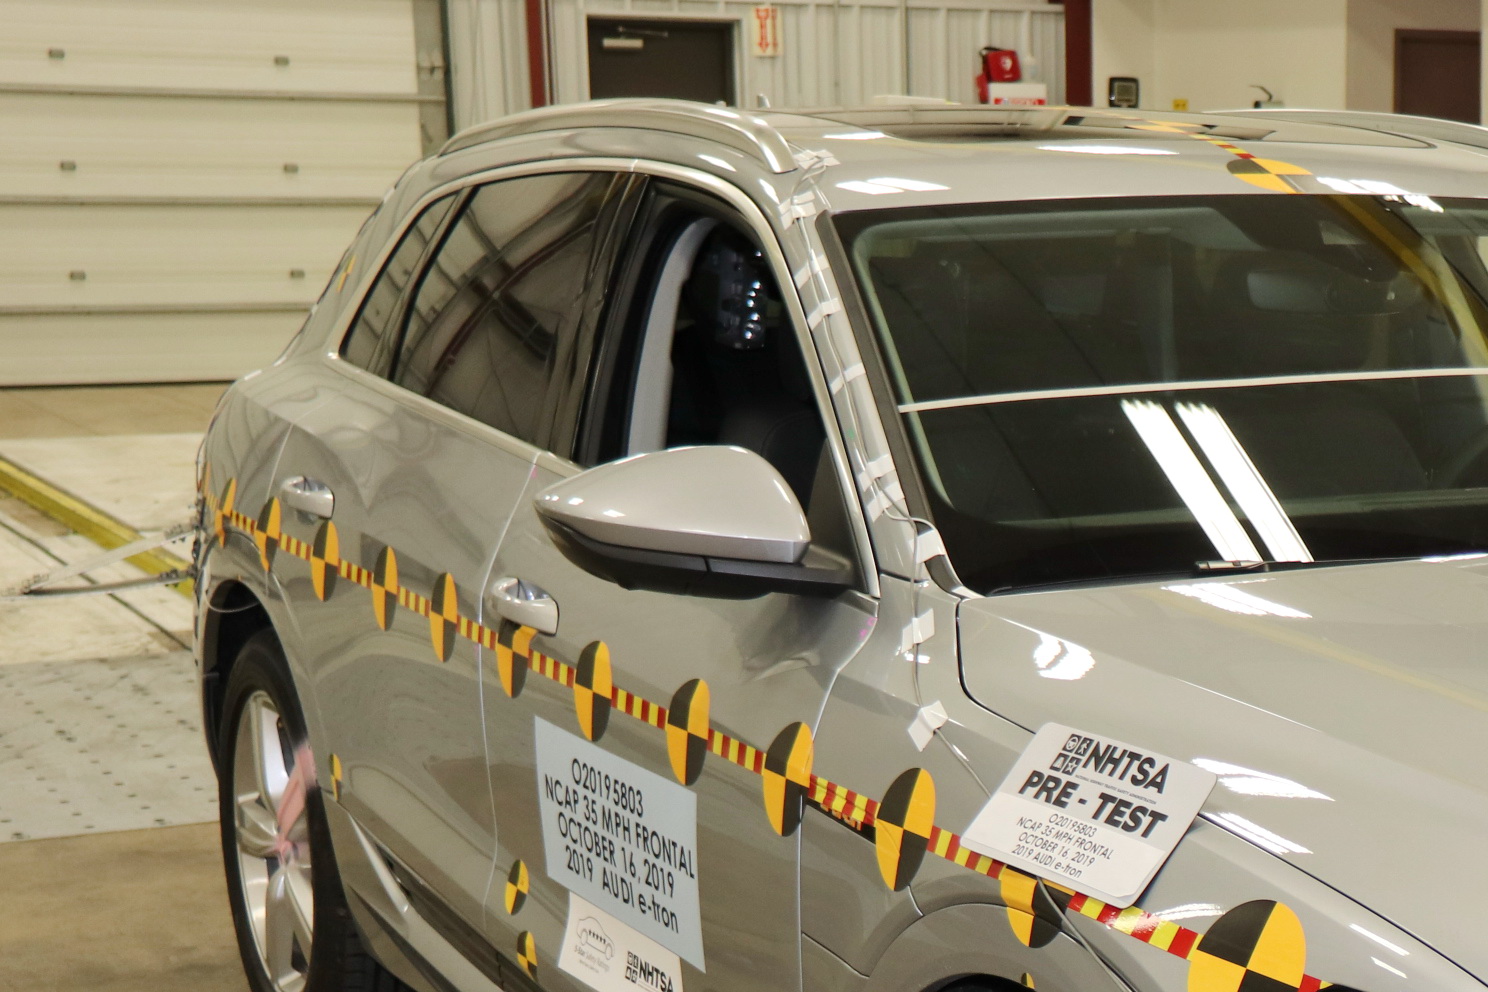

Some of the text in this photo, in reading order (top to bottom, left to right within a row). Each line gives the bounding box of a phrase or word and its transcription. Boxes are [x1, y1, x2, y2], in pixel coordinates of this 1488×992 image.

[571, 758, 644, 818] O20195803
[1080, 741, 1170, 795] NHTSA
[545, 773, 695, 879] NCAP 35 MPH FRONTAL
[1017, 770, 1080, 809] PRE
[1091, 792, 1169, 839] TEST
[558, 811, 675, 898] OCTOBER 16, 2019
[1011, 844, 1083, 879] 2019 AUDI e-tron
[1016, 816, 1114, 861] NCAP 35 MPH FRONTAL
[1018, 831, 1096, 868] OCTOBER 16, 2019
[565, 845, 679, 934] 2019 AUDI e-tron
